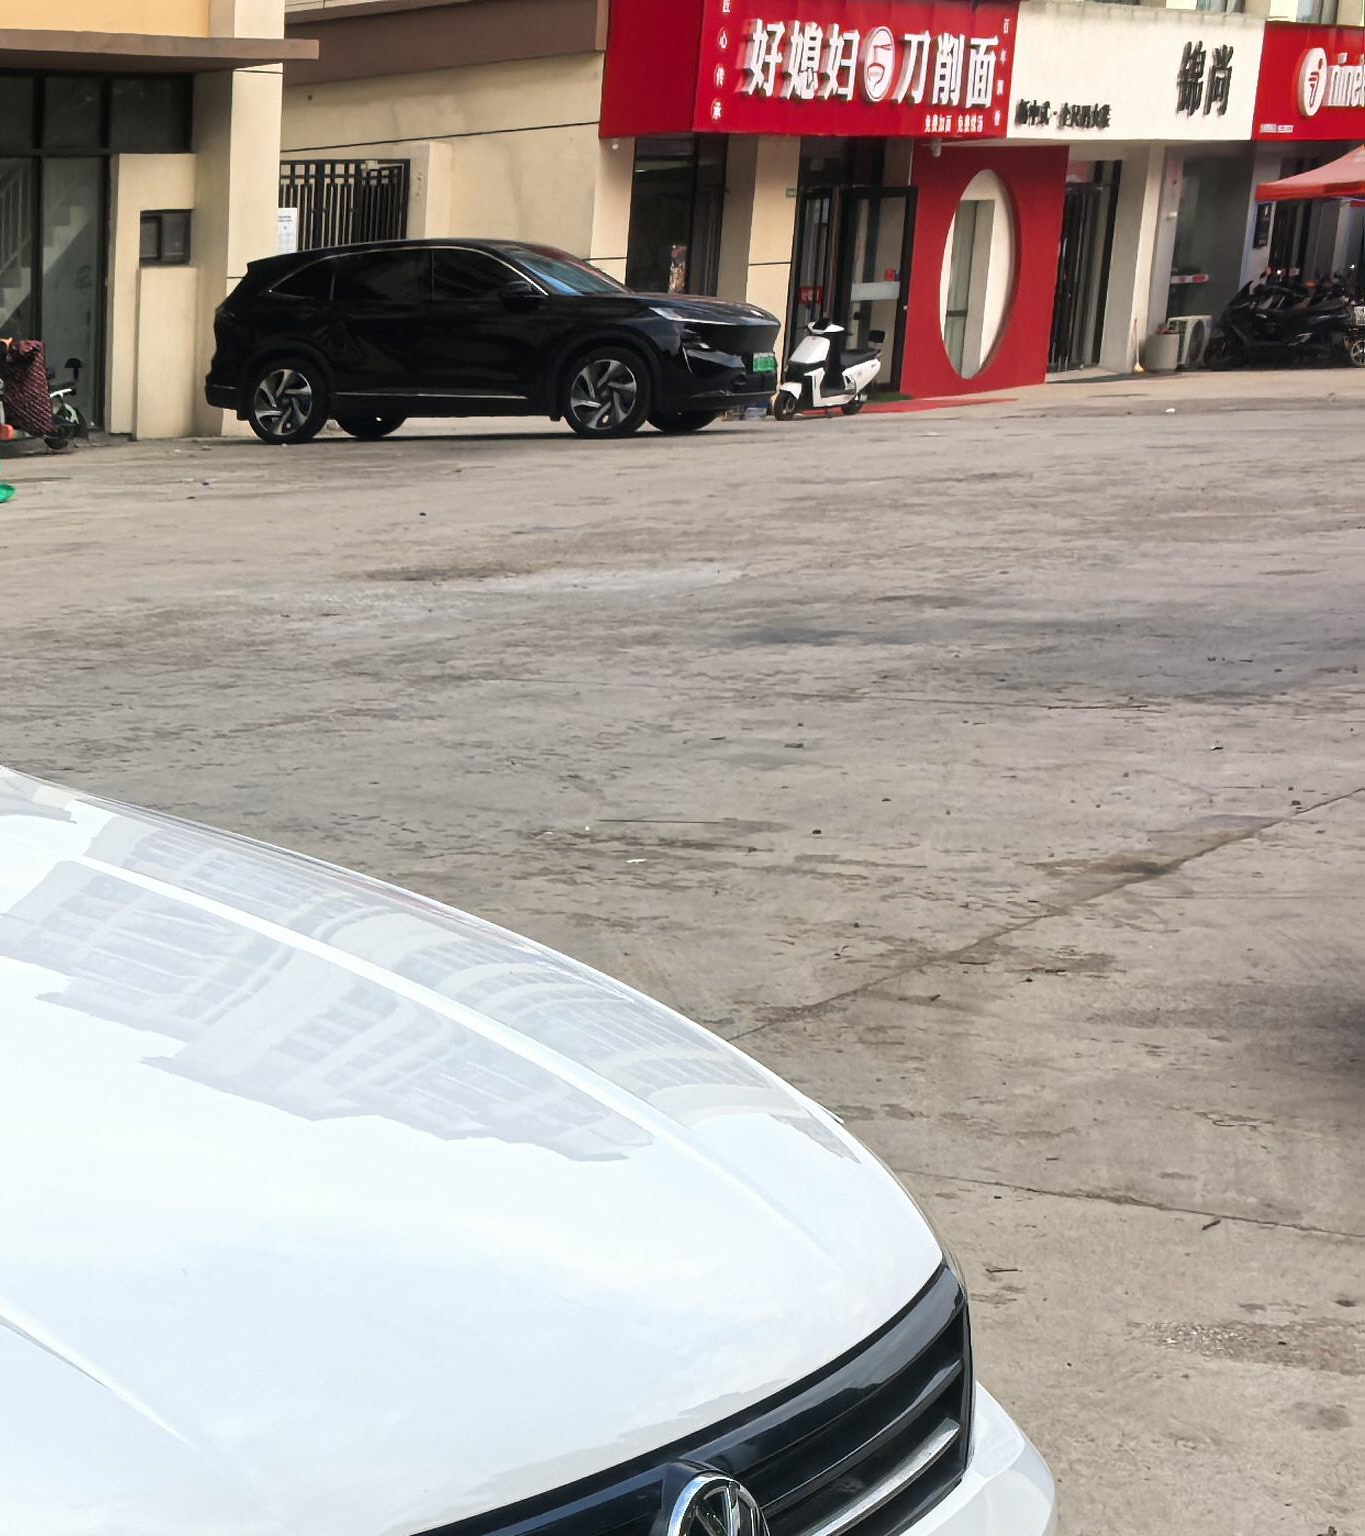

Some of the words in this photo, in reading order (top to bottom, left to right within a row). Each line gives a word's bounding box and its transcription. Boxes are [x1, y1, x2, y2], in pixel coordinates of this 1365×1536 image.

[743, 18, 861, 101] 好媳妇
[894, 30, 999, 108] 刀削面
